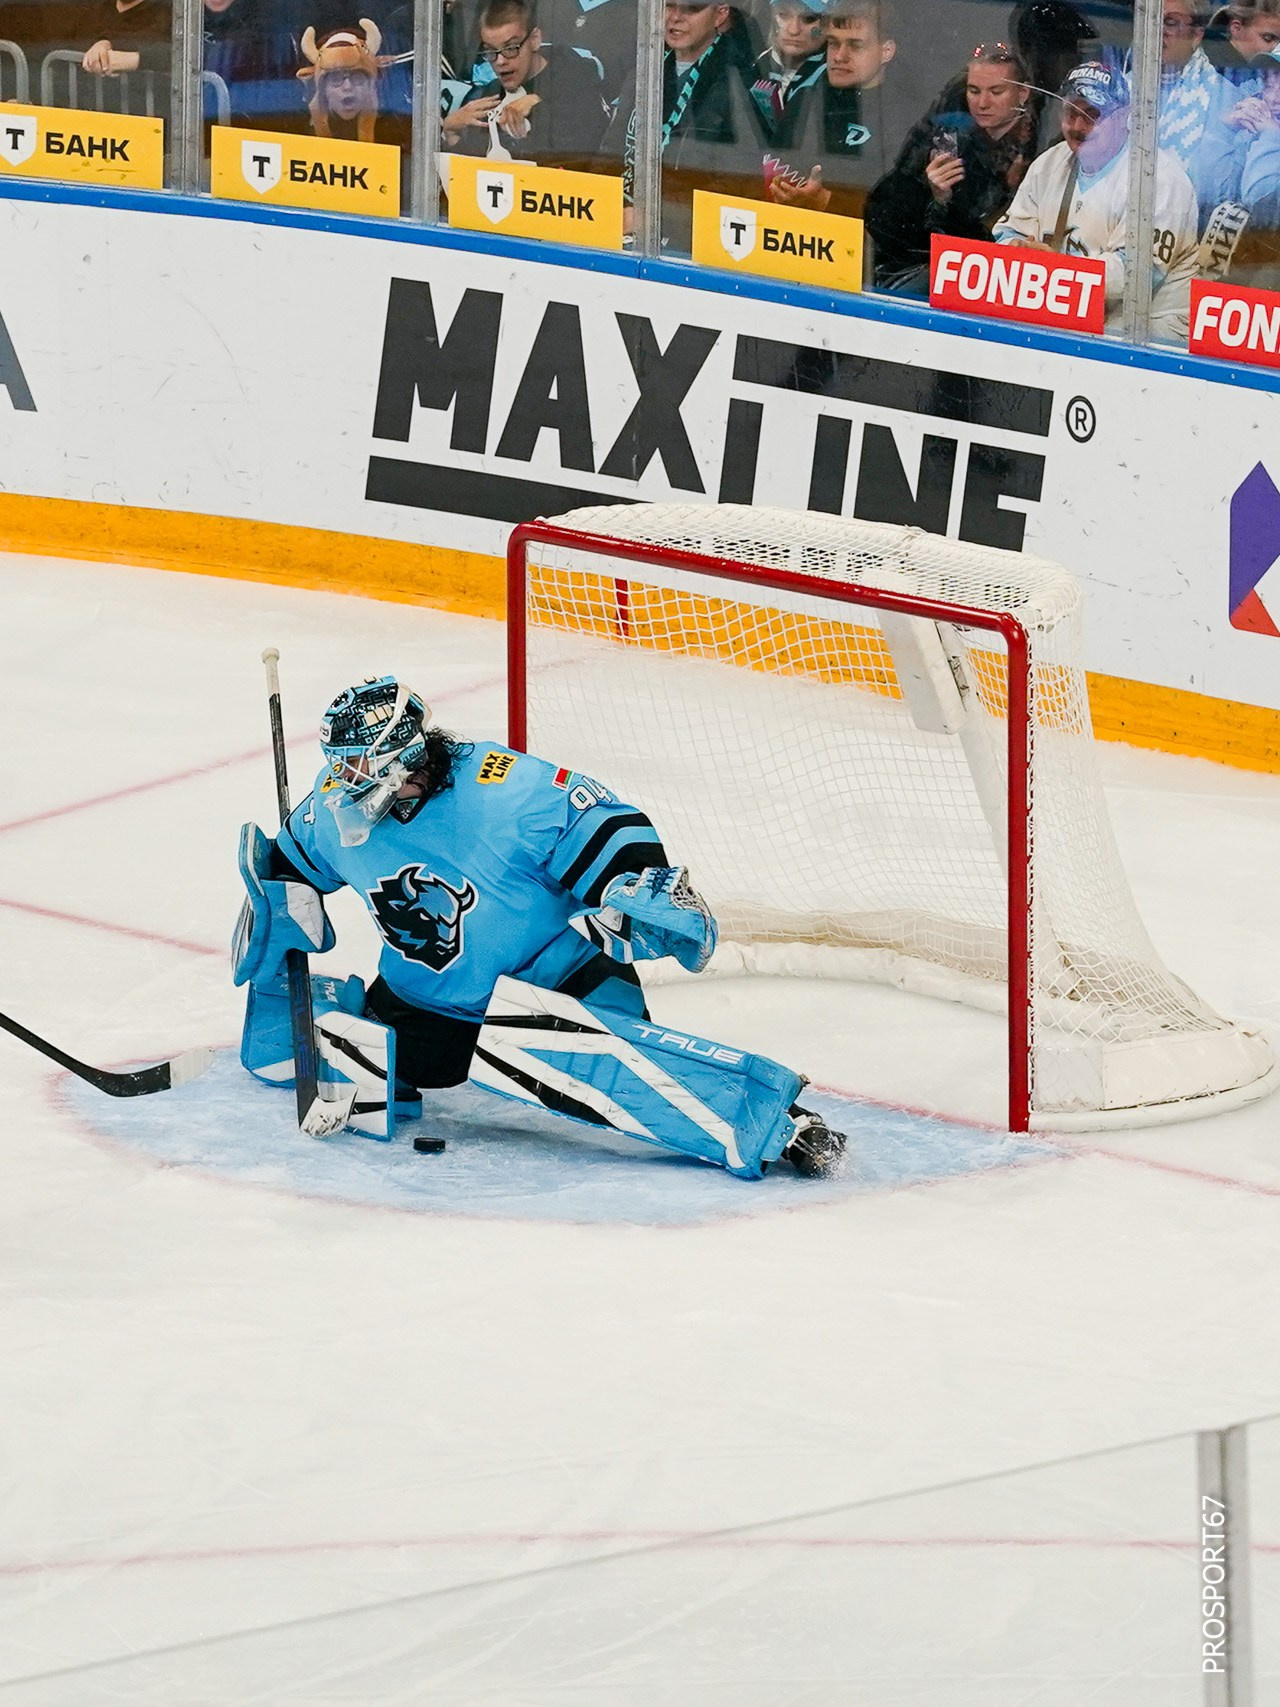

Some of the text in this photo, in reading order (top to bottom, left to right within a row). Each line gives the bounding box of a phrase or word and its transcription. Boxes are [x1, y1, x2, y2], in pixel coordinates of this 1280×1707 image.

[45, 132, 130, 162] БАНК
[290, 159, 369, 190] БАНК
[521, 190, 594, 221] БАНК
[763, 228, 835, 263] БАНК
[933, 250, 1103, 318] FONBET
[1192, 295, 1280, 353] FON
[480, 753, 501, 780] MAX
[493, 755, 515, 779] LINE
[570, 775, 614, 812] 94
[631, 1023, 746, 1065] TRUE
